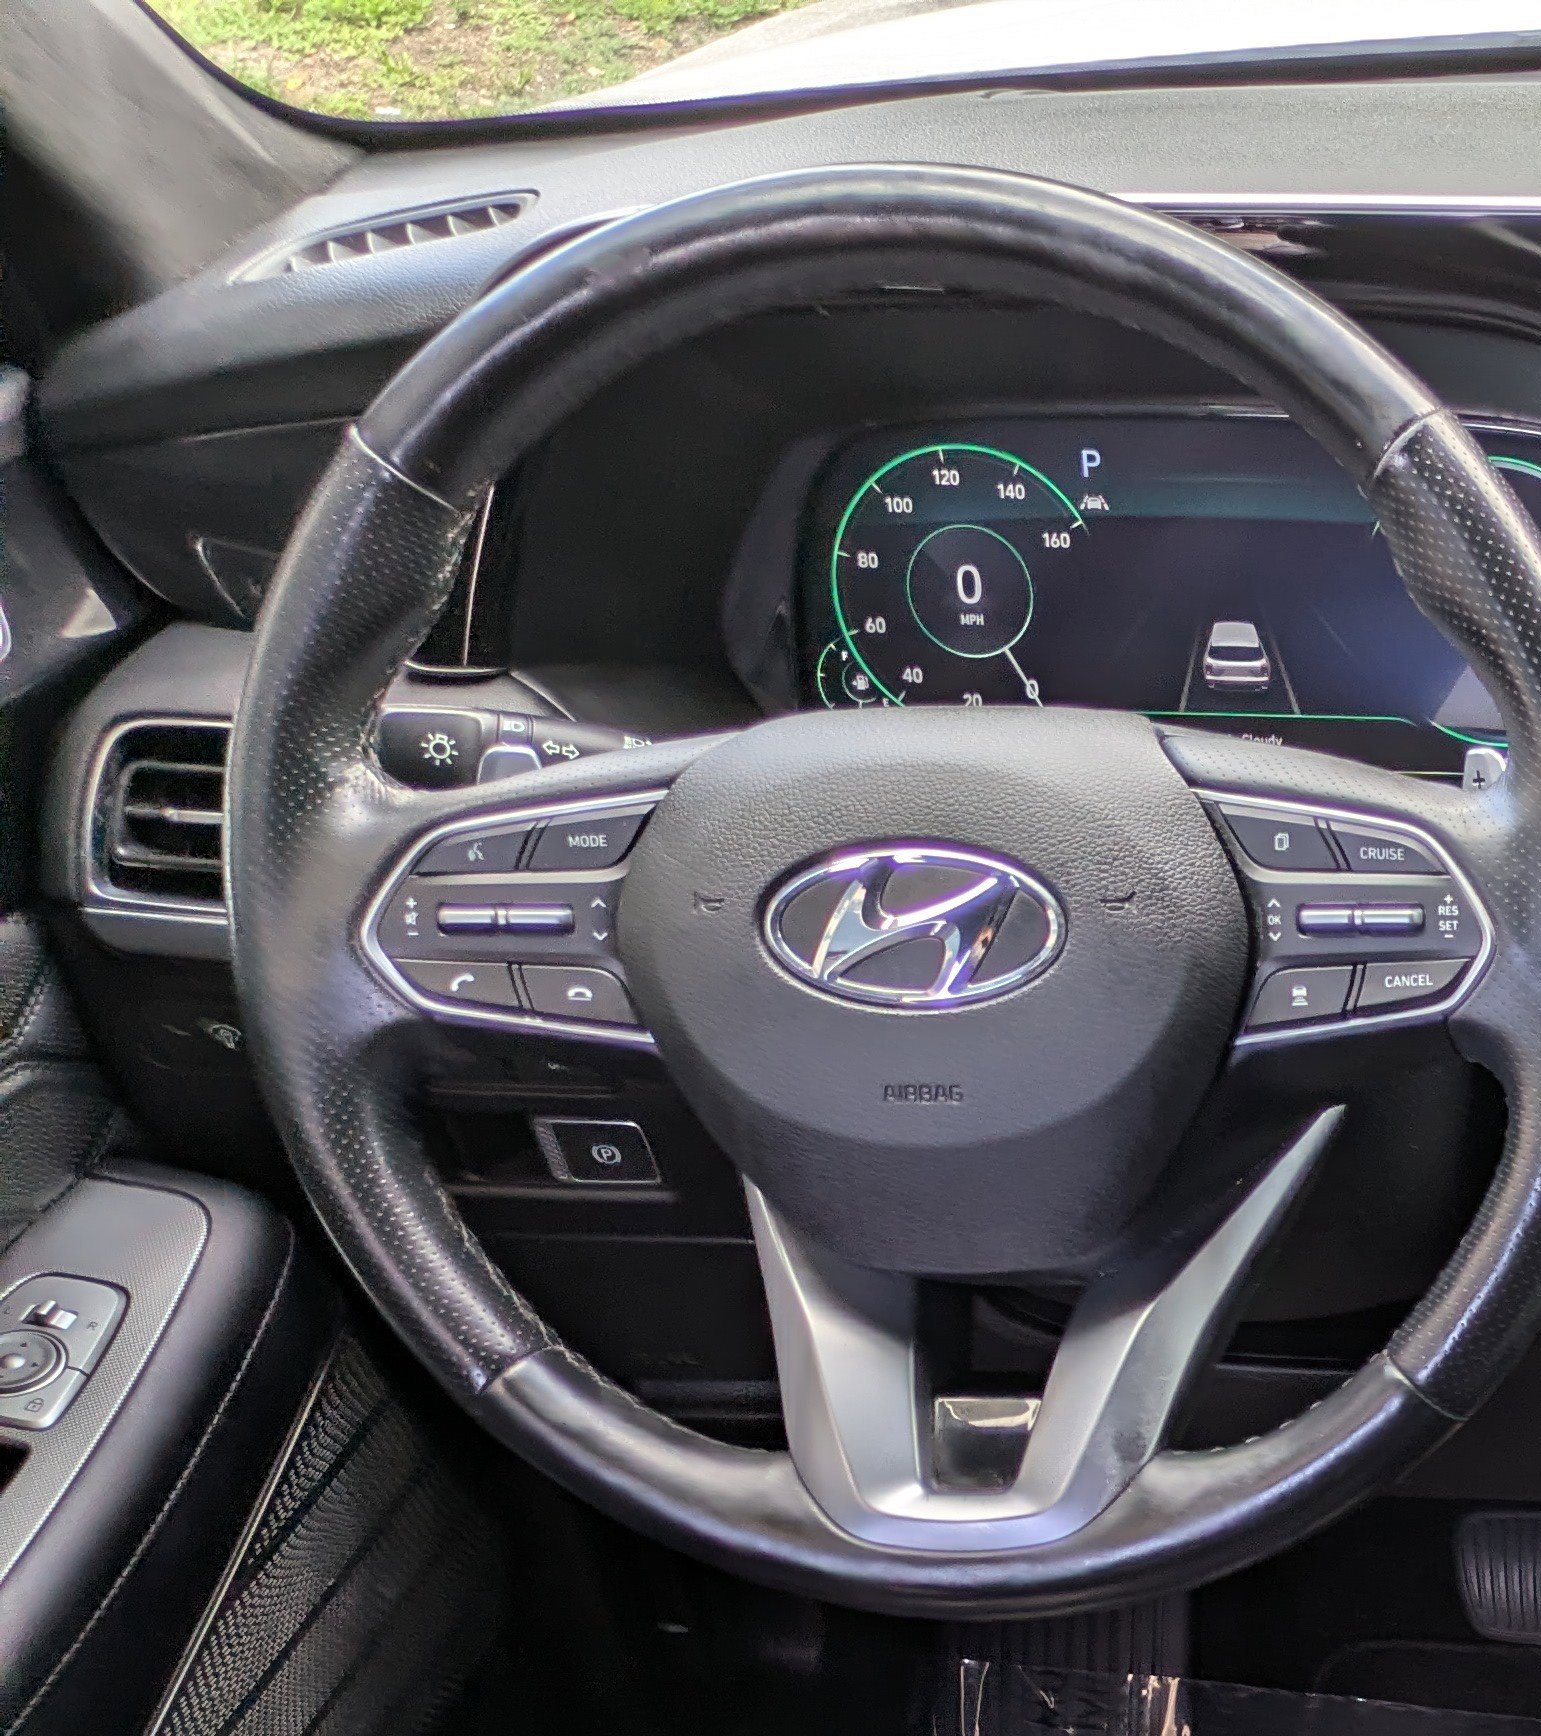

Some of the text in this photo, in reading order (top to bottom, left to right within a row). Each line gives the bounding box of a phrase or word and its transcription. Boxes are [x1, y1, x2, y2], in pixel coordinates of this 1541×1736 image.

[1081, 449, 1101, 478] P
[932, 469, 959, 486] 120
[997, 484, 1025, 500] 140
[885, 497, 912, 513] 100
[1042, 532, 1070, 548] 160
[857, 552, 878, 568] 80
[957, 564, 982, 604] 0
[865, 617, 886, 634] 60
[960, 614, 984, 626] MPH
[902, 666, 923, 683] 40
[963, 693, 983, 707] 20
[568, 835, 608, 848] MODE
[1360, 847, 1405, 861] CRUISE
[1438, 905, 1459, 916] RES
[1267, 915, 1281, 925] OK
[1438, 920, 1459, 932] SET
[1385, 974, 1433, 988] CANCEL
[883, 1083, 964, 1103] AIRBAG
